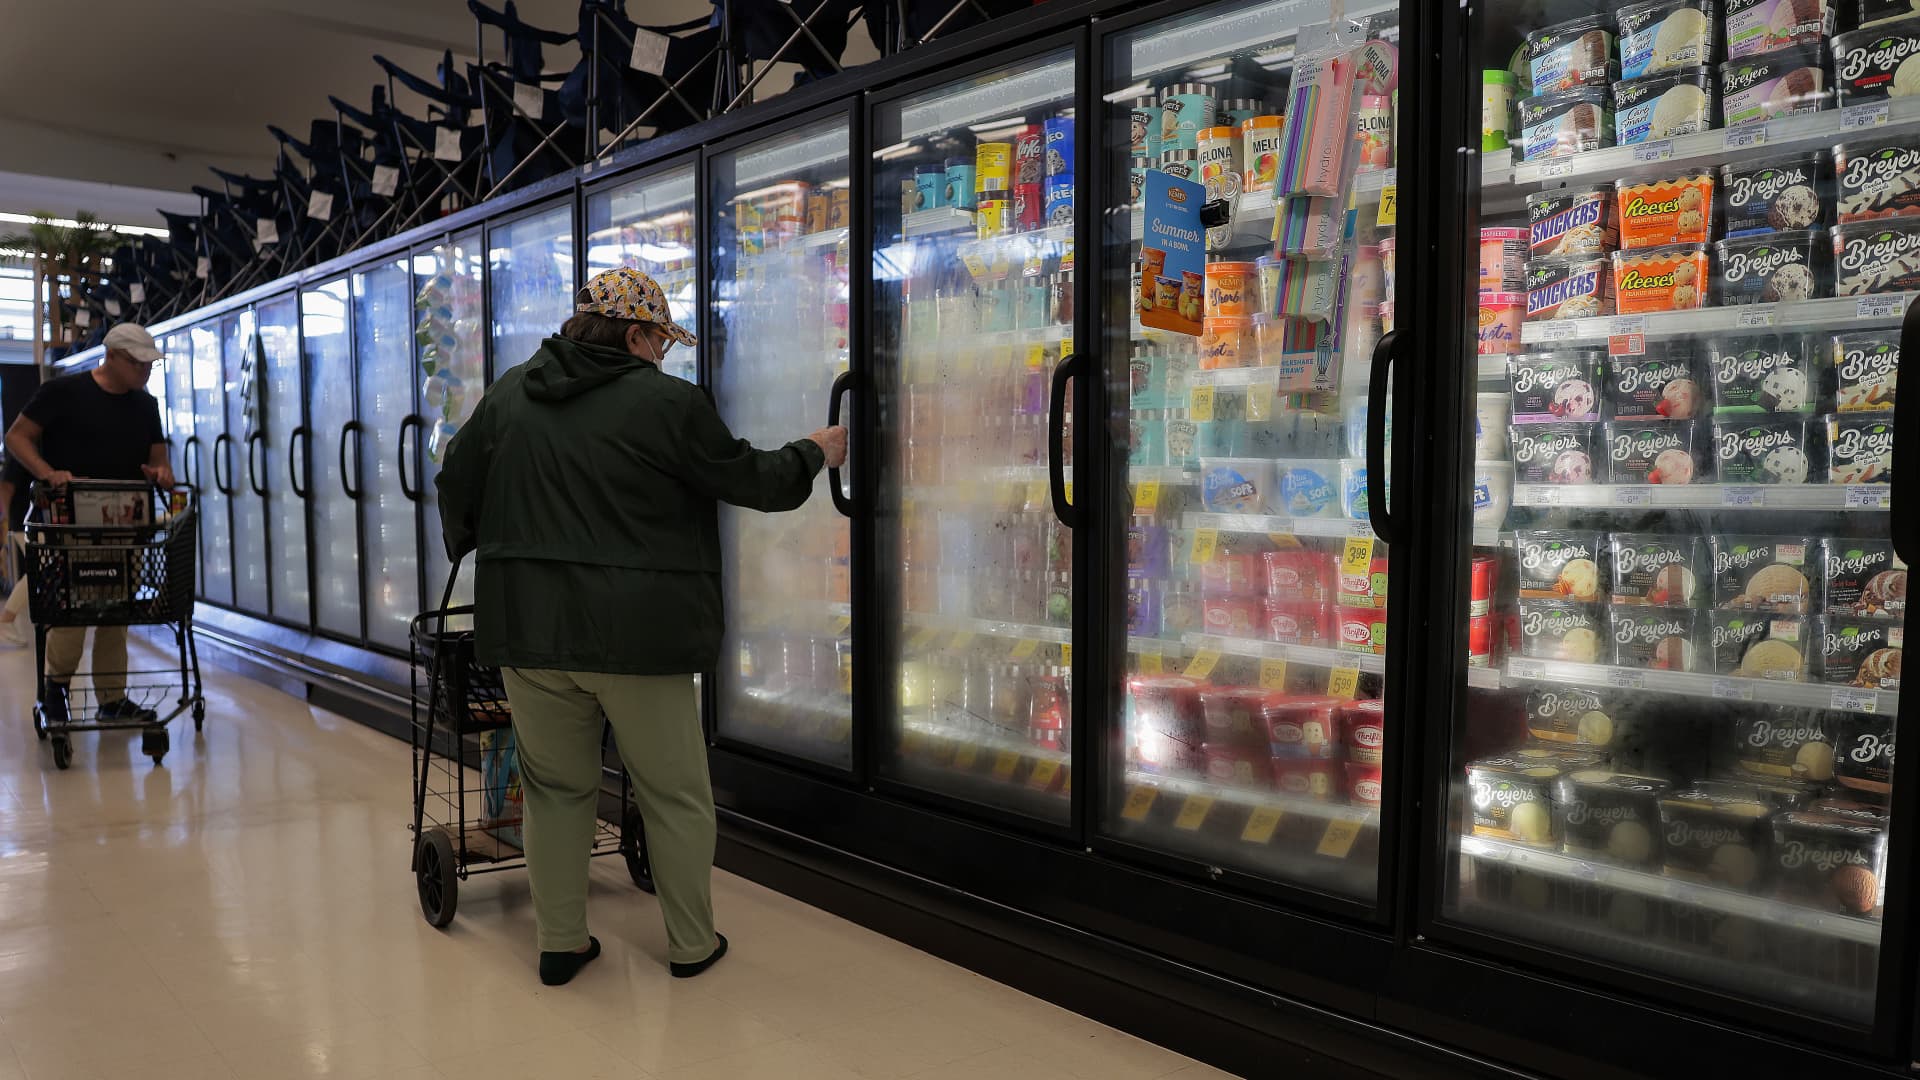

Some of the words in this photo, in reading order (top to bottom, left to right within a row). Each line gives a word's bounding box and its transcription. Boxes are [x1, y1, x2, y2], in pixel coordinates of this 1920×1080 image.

[1531, 36, 1560, 57] Breyers
[1364, 46, 1391, 81] MELONA
[1723, 65, 1769, 95] Breyers
[1616, 87, 1648, 110] Breyers
[1358, 115, 1391, 132] ELONA
[1524, 105, 1553, 125] Breyers
[1252, 137, 1283, 154] MELO
[1729, 168, 1808, 207] Breyers
[1530, 200, 1560, 223] Breyers
[1624, 197, 1680, 219] Reese's
[1151, 217, 1200, 243] Summer
[1531, 200, 1600, 245] SNICKERS
[1725, 246, 1803, 282] Breyers
[1527, 269, 1557, 290] Breyers
[1528, 271, 1597, 313] SNICKERS
[1620, 270, 1676, 291] Reese's
[1514, 364, 1583, 393] Breyers
[1618, 362, 1691, 393] Breyers
[1717, 351, 1795, 384] Breyers
[1841, 349, 1900, 380] Breye
[1516, 435, 1582, 463] Breyers
[1612, 433, 1683, 461] Breyers
[1719, 429, 1796, 460] Breyers
[1835, 428, 1894, 459] Brey
[1522, 544, 1591, 569] Breyers
[1617, 547, 1686, 574] Breyers
[1716, 545, 1770, 575] Breyers
[1827, 550, 1886, 580] Breyers
[79, 569, 108, 577] SAFEWAY
[1343, 626, 1369, 640] Thrifty
[1524, 611, 1591, 636] Breyers
[1616, 618, 1686, 644] Breyers
[1711, 620, 1764, 648] Breyers
[1822, 628, 1881, 657] Breyers
[1537, 692, 1604, 717] Breyers
[1748, 720, 1827, 748] Breyers
[1473, 782, 1537, 808] Breyers
[1567, 801, 1638, 825] Breyers
[1667, 820, 1744, 849] Breyers
[1780, 840, 1868, 872] Breyers
